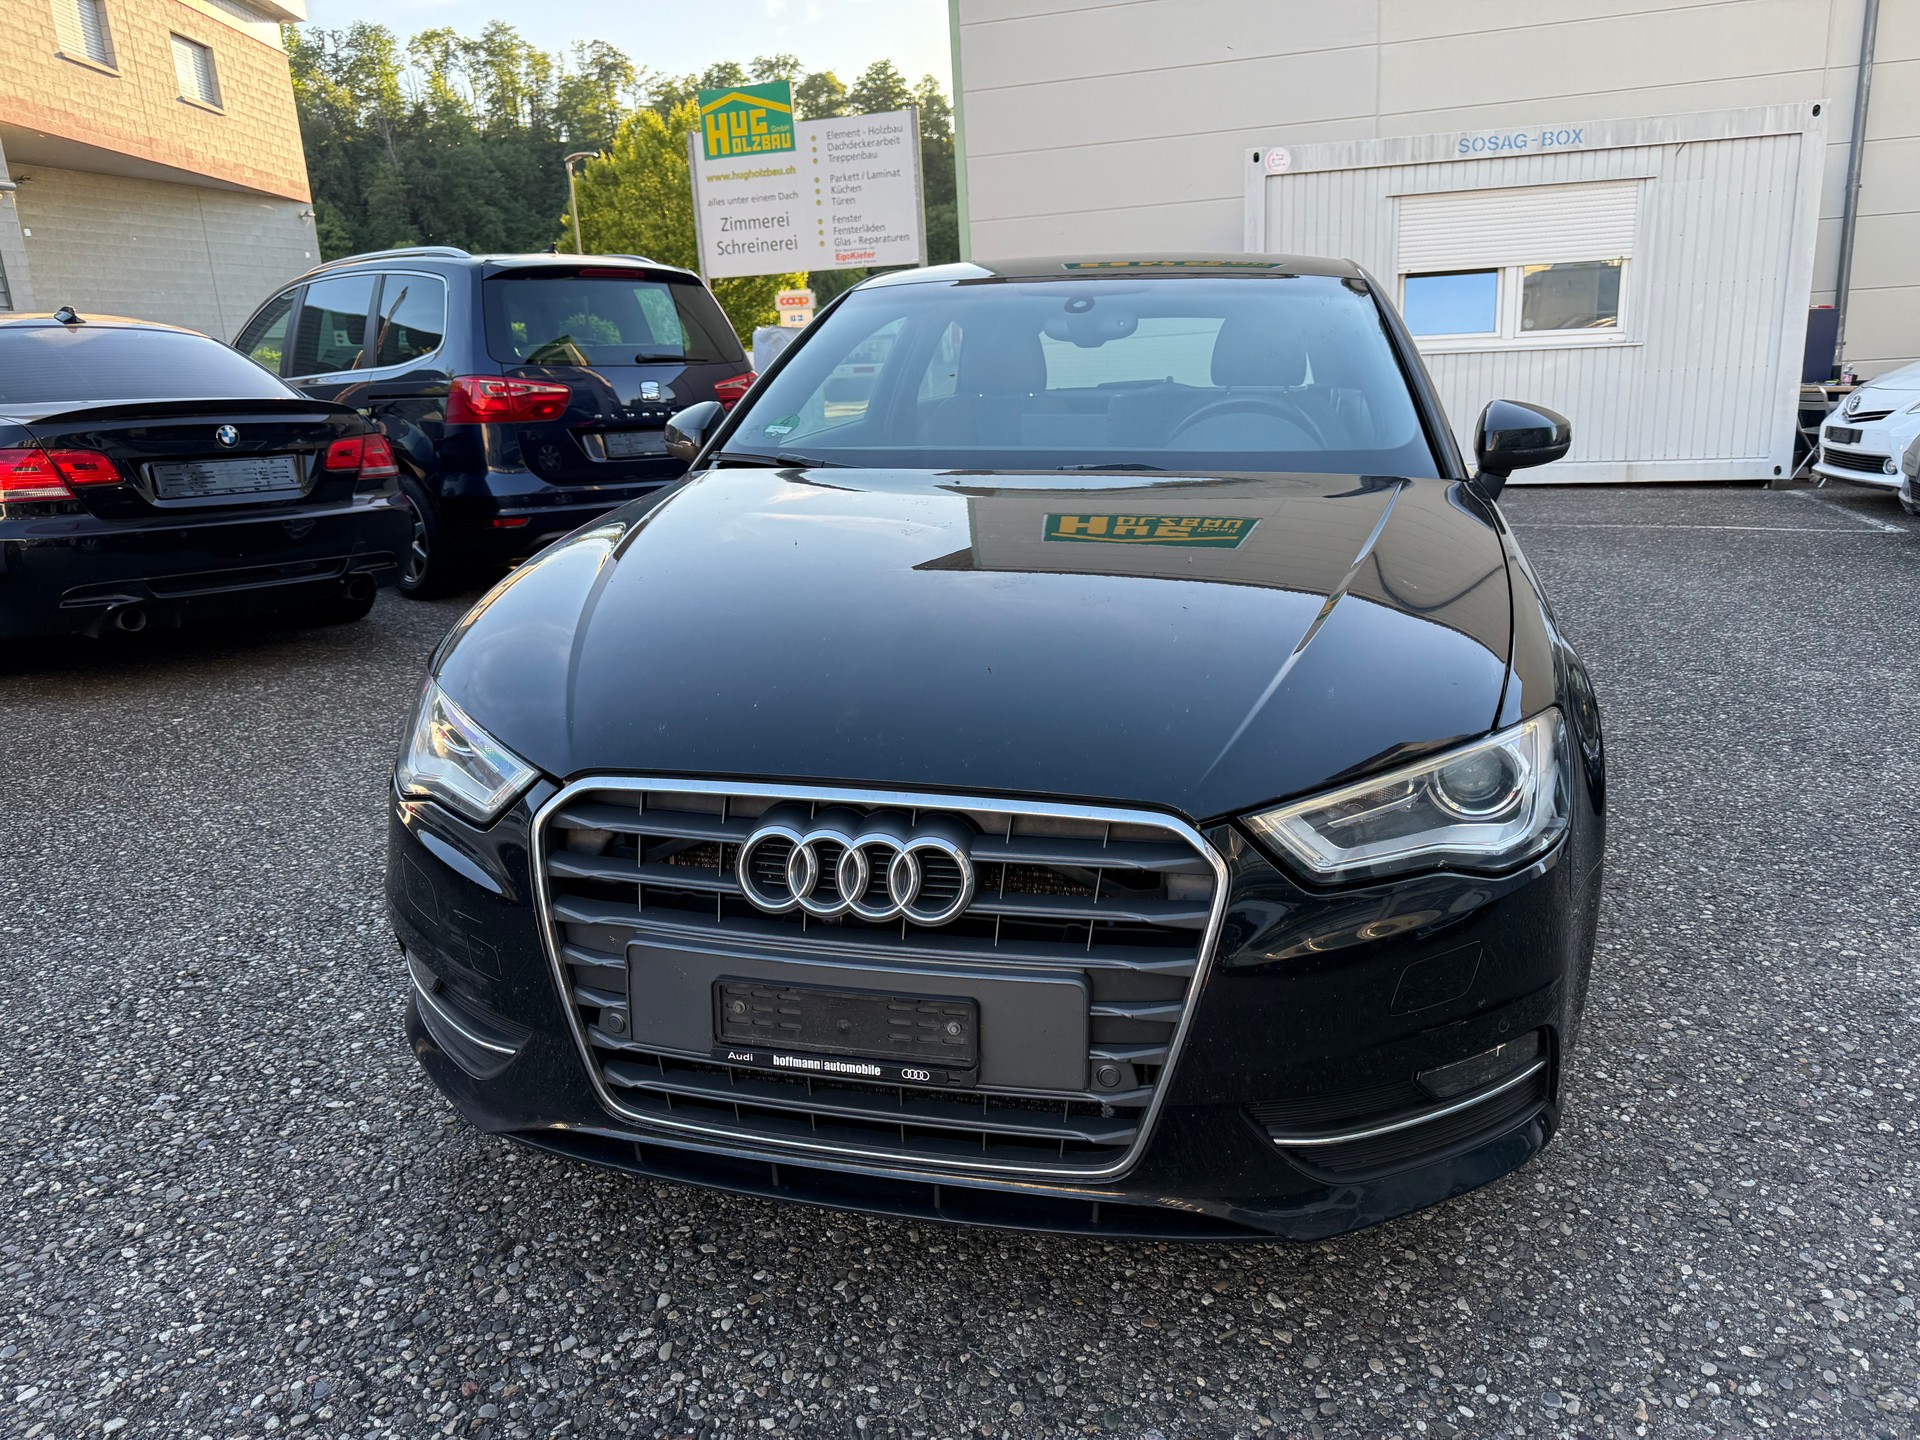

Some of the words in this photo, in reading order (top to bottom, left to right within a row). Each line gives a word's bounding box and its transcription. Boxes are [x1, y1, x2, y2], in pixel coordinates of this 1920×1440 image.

[705, 109, 768, 156] HUG
[826, 128, 861, 140] Element
[867, 123, 903, 136] Holzbau
[827, 136, 901, 152] Dachdeckerarbeit
[1458, 129, 1584, 153] SOSAG-BOX
[828, 151, 878, 164] Treppenbau
[706, 165, 796, 183] www.hugholzbau.ch
[829, 172, 860, 183] Parkett
[866, 168, 901, 180] Laminat
[831, 184, 862, 194] Küchen
[707, 198, 726, 207] alles
[727, 197, 749, 205] unter
[750, 193, 776, 203] einem
[777, 190, 799, 201] Dach
[832, 196, 856, 206] Türen
[720, 211, 790, 232] Zimmerei
[832, 214, 862, 224] Fenster
[833, 223, 886, 235] Fensterläden
[716, 234, 798, 256] Schreinerei
[834, 237, 851, 247] Glas
[858, 233, 910, 246] Reparaturen
[835, 251, 876, 262] EgoKiefer
[780, 296, 809, 307] coop
[727, 1051, 753, 1062] Audi
